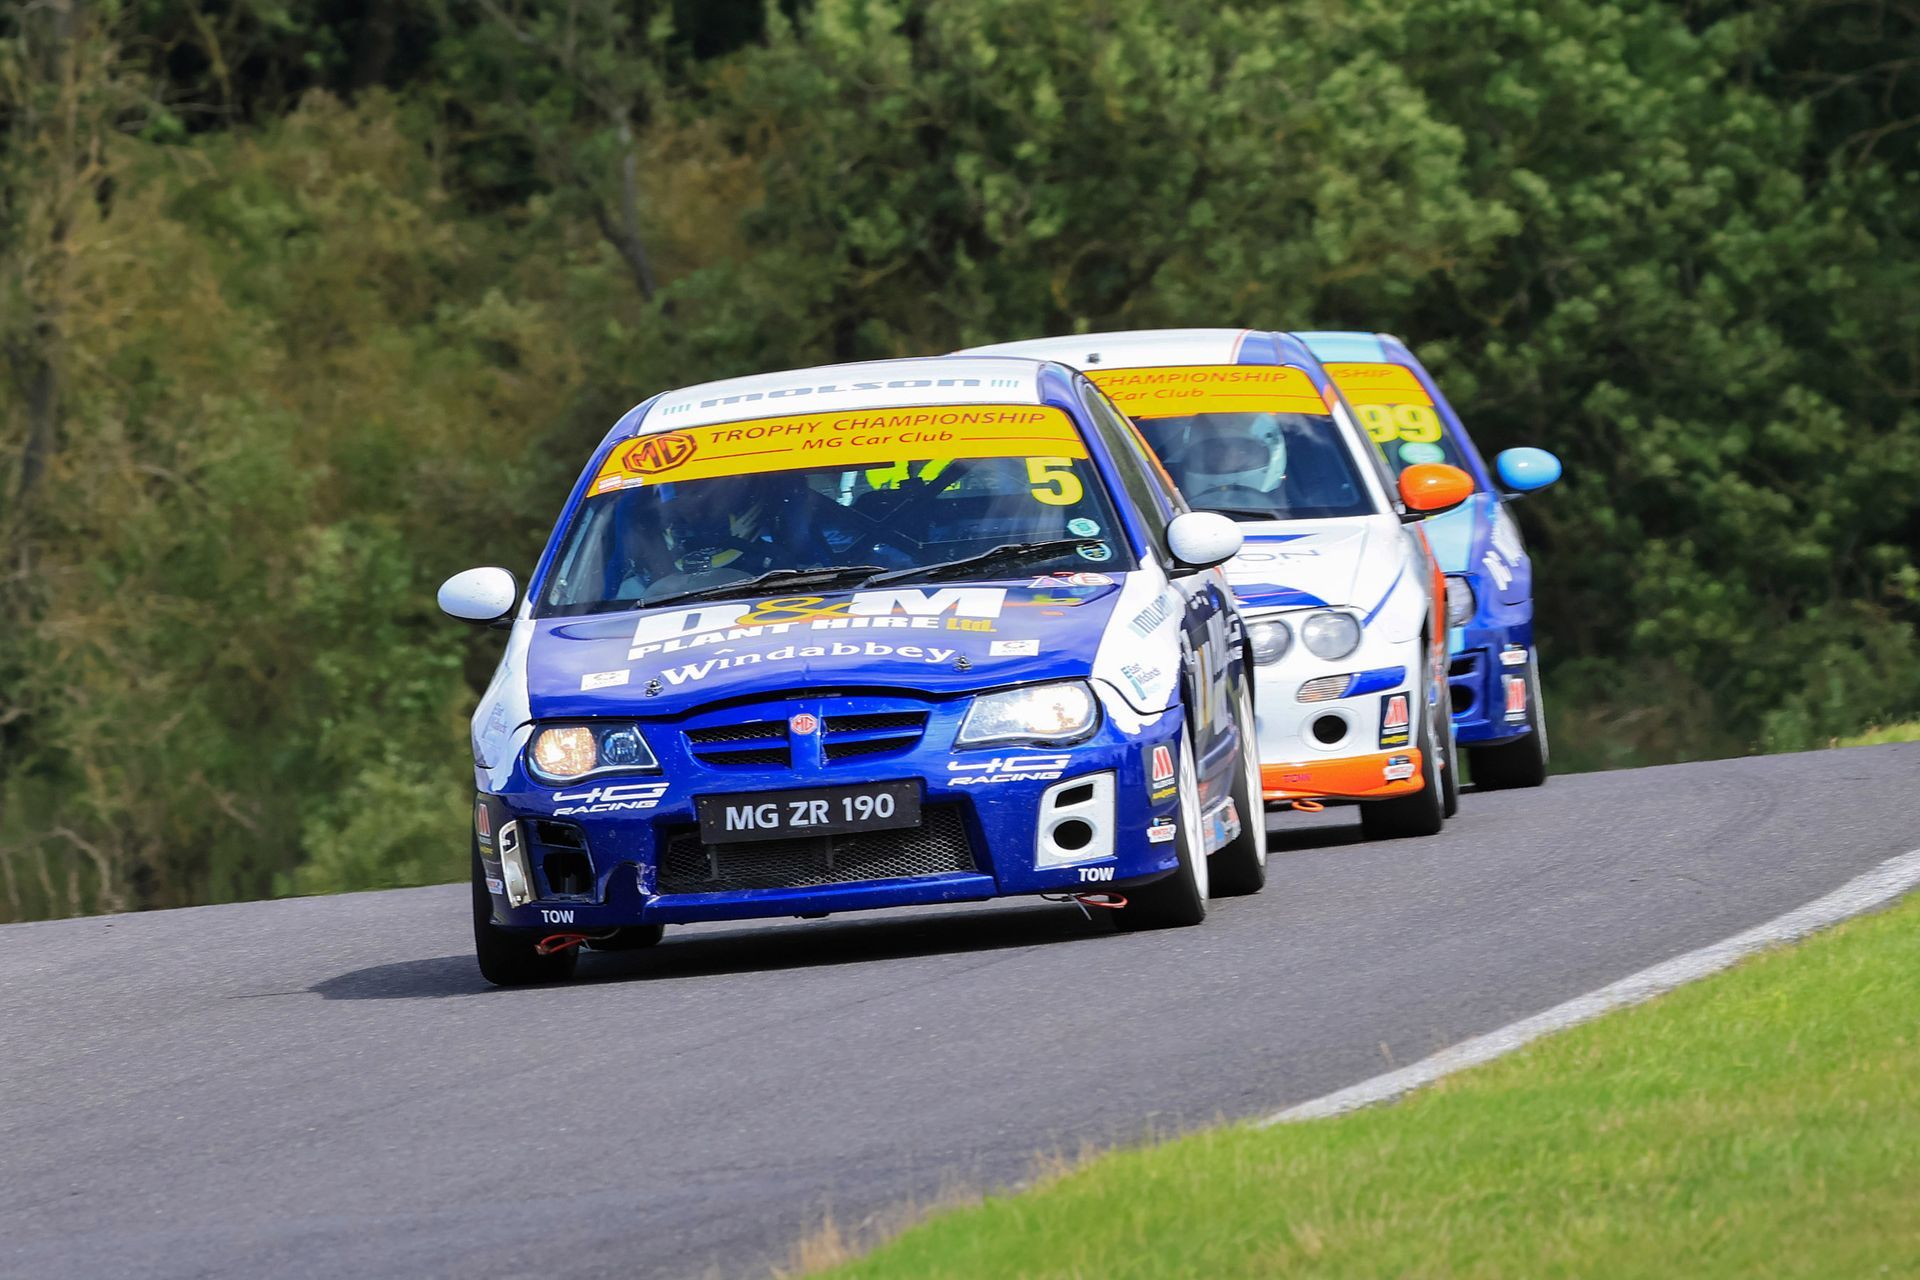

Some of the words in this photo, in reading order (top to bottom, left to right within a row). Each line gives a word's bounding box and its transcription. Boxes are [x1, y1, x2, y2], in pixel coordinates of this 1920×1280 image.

[1095, 372, 1287, 387] CHAMPIONSHIP
[1154, 389, 1204, 399] Club
[711, 421, 821, 443] TROPHY
[834, 412, 1046, 431] CHAMPIONSHIP
[1352, 404, 1443, 443] 99
[802, 438, 843, 449] MG
[850, 435, 893, 446] Car
[899, 431, 953, 443] Club
[629, 436, 689, 471] MG
[1025, 456, 1083, 506] 5
[627, 621, 800, 661] PLANT
[811, 617, 940, 630] HIRE
[947, 771, 1063, 786] RACING
[552, 800, 659, 817] RACING
[725, 803, 779, 831] MG
[788, 800, 829, 826] ZR
[842, 793, 895, 822] 190
[1078, 867, 1115, 882] TOW
[540, 910, 574, 923] TOW
